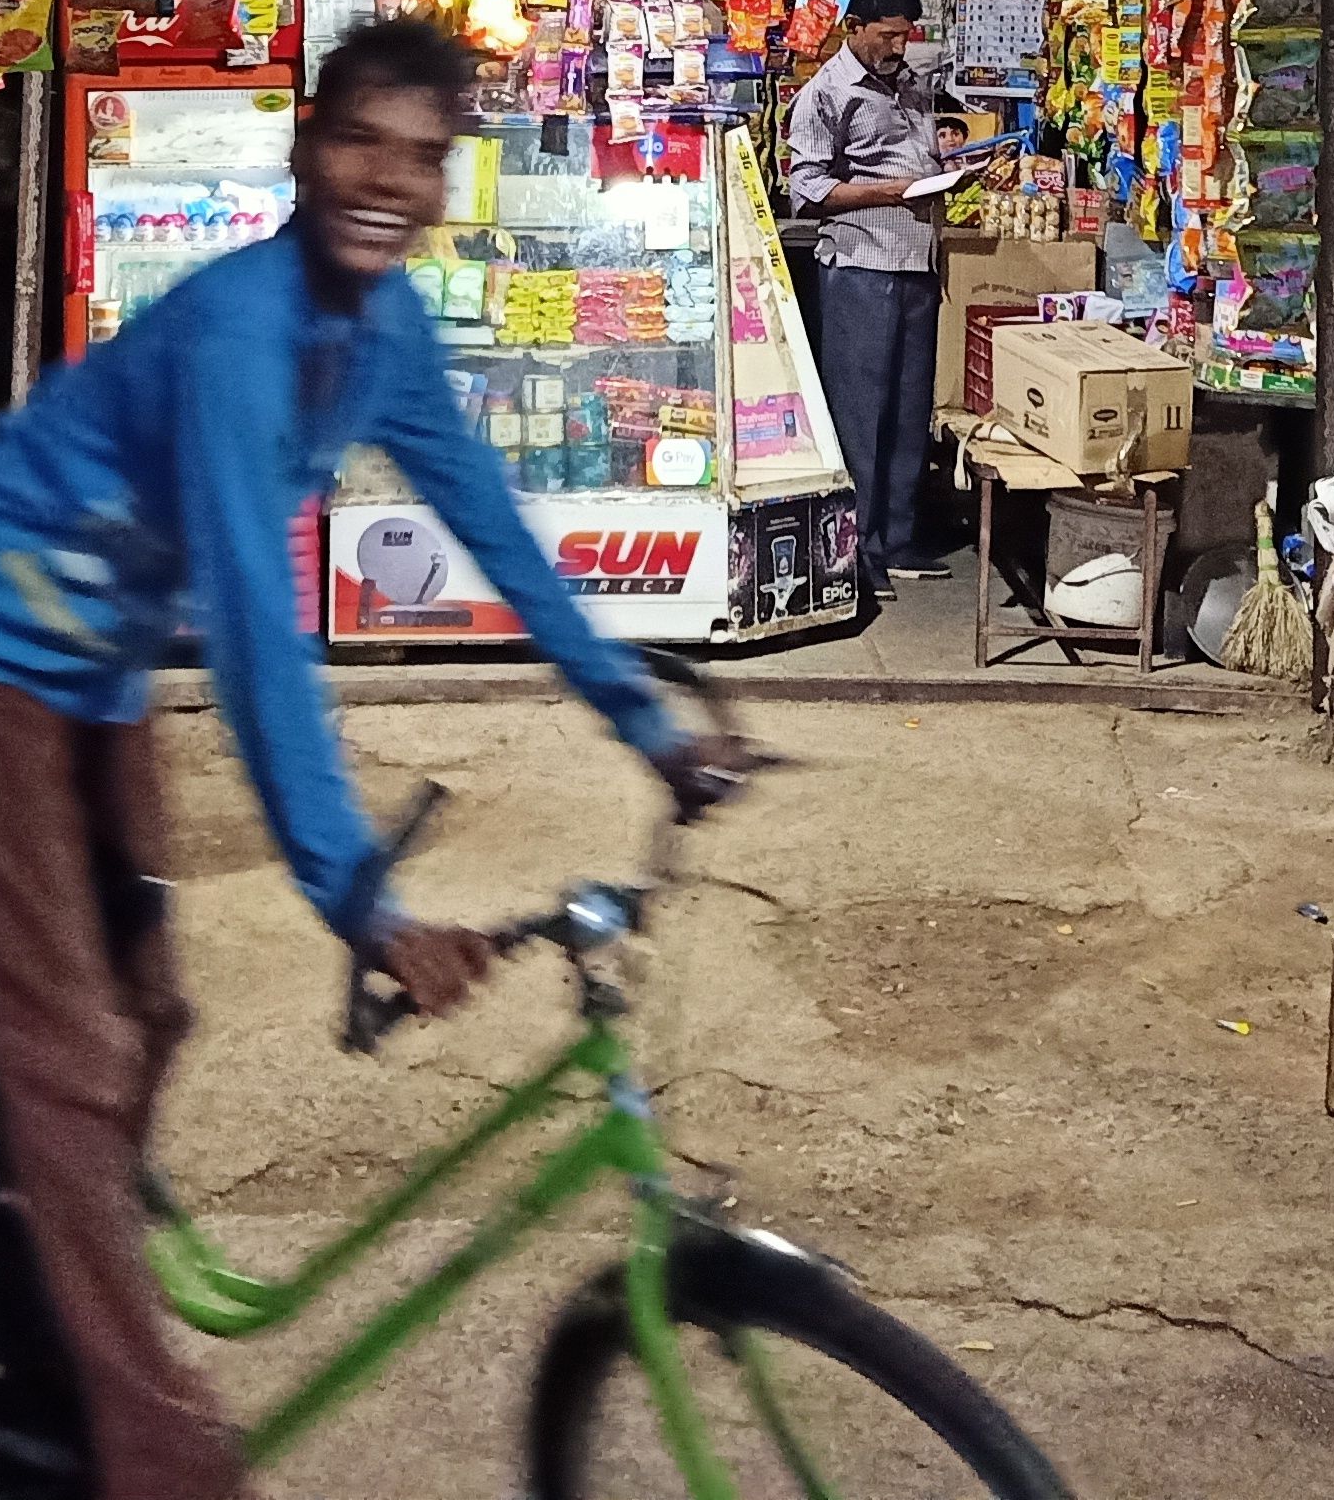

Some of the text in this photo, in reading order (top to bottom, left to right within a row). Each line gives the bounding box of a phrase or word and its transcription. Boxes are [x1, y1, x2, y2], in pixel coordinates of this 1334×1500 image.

[675, 451, 697, 465] Pay
[555, 530, 702, 577] SUN
[568, 579, 676, 593] IRECT
[822, 581, 853, 604] EPIC
